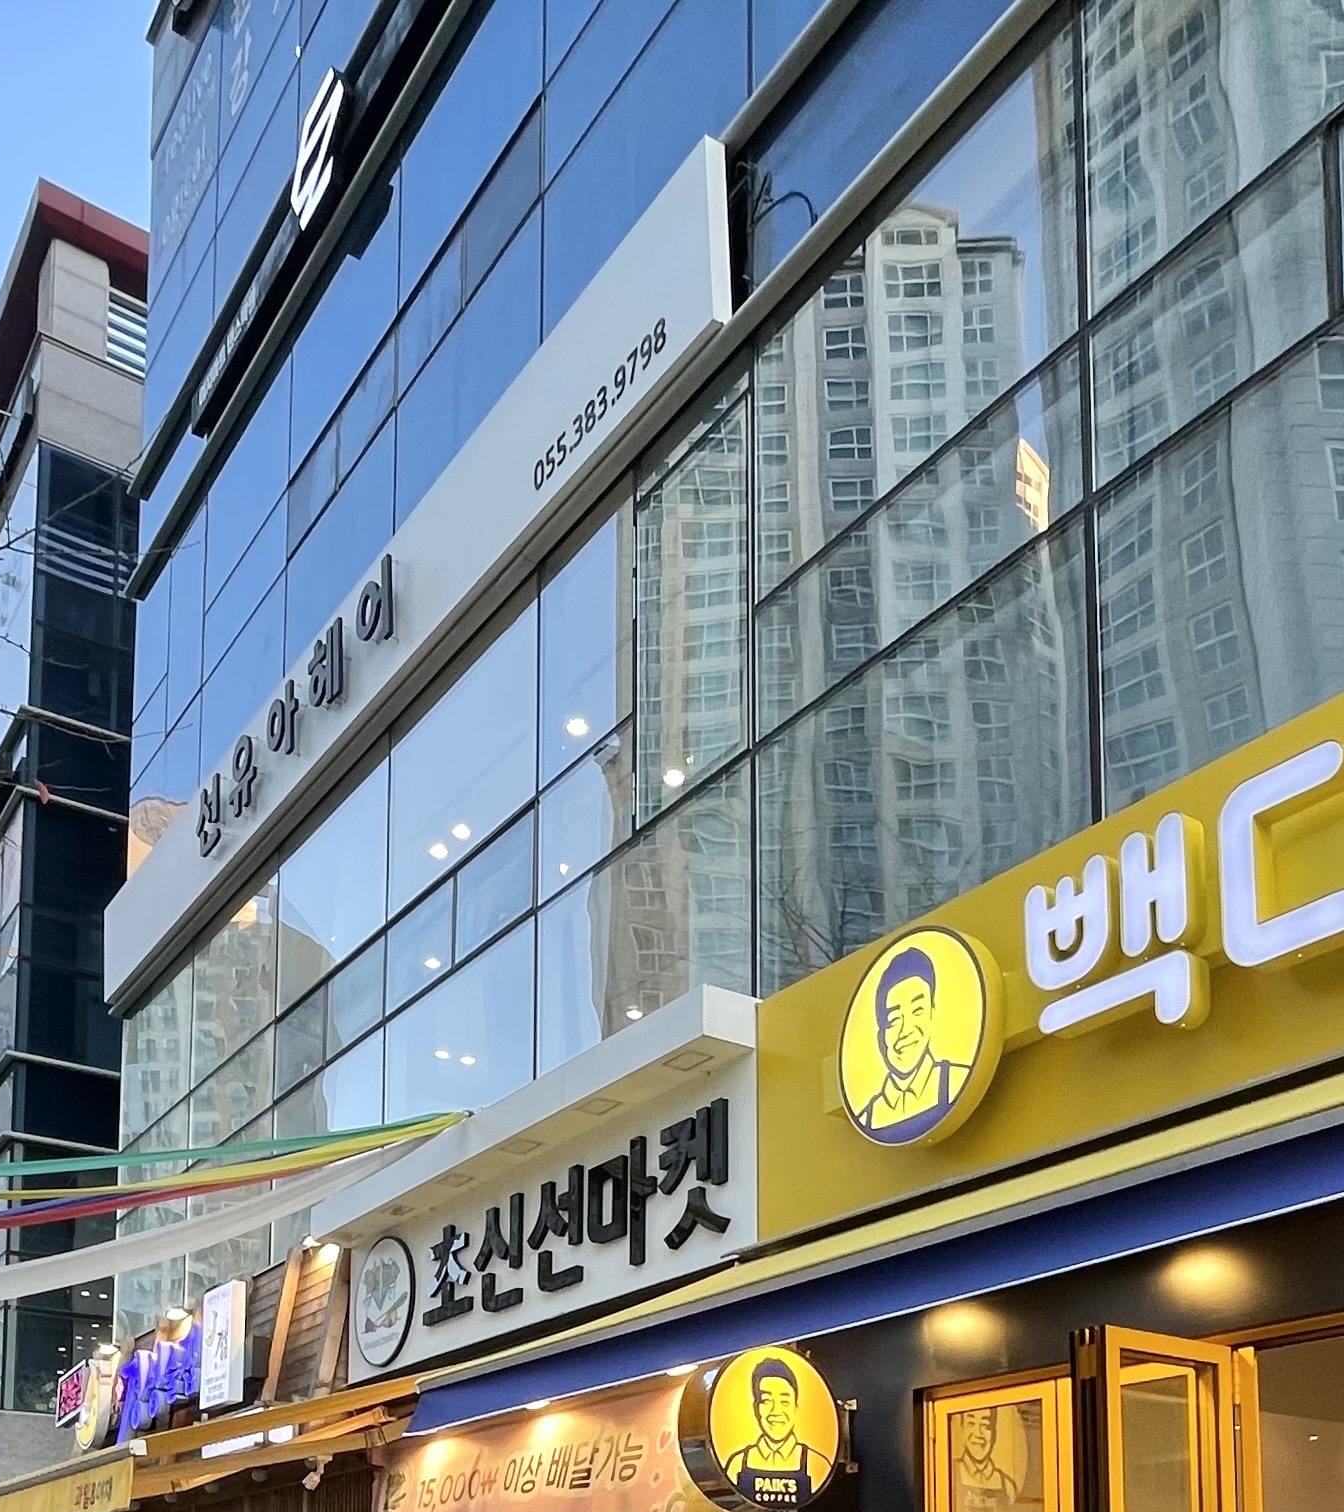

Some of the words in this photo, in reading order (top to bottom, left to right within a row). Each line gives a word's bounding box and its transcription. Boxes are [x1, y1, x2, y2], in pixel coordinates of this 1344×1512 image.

[533, 317, 667, 491] 055.383.9798
[423, 1098, 731, 1326] 초신선마켓
[504, 1453, 542, 1494] 이상
[754, 1477, 797, 1493] PAIK'S
[755, 1493, 797, 1503] COFFEE
